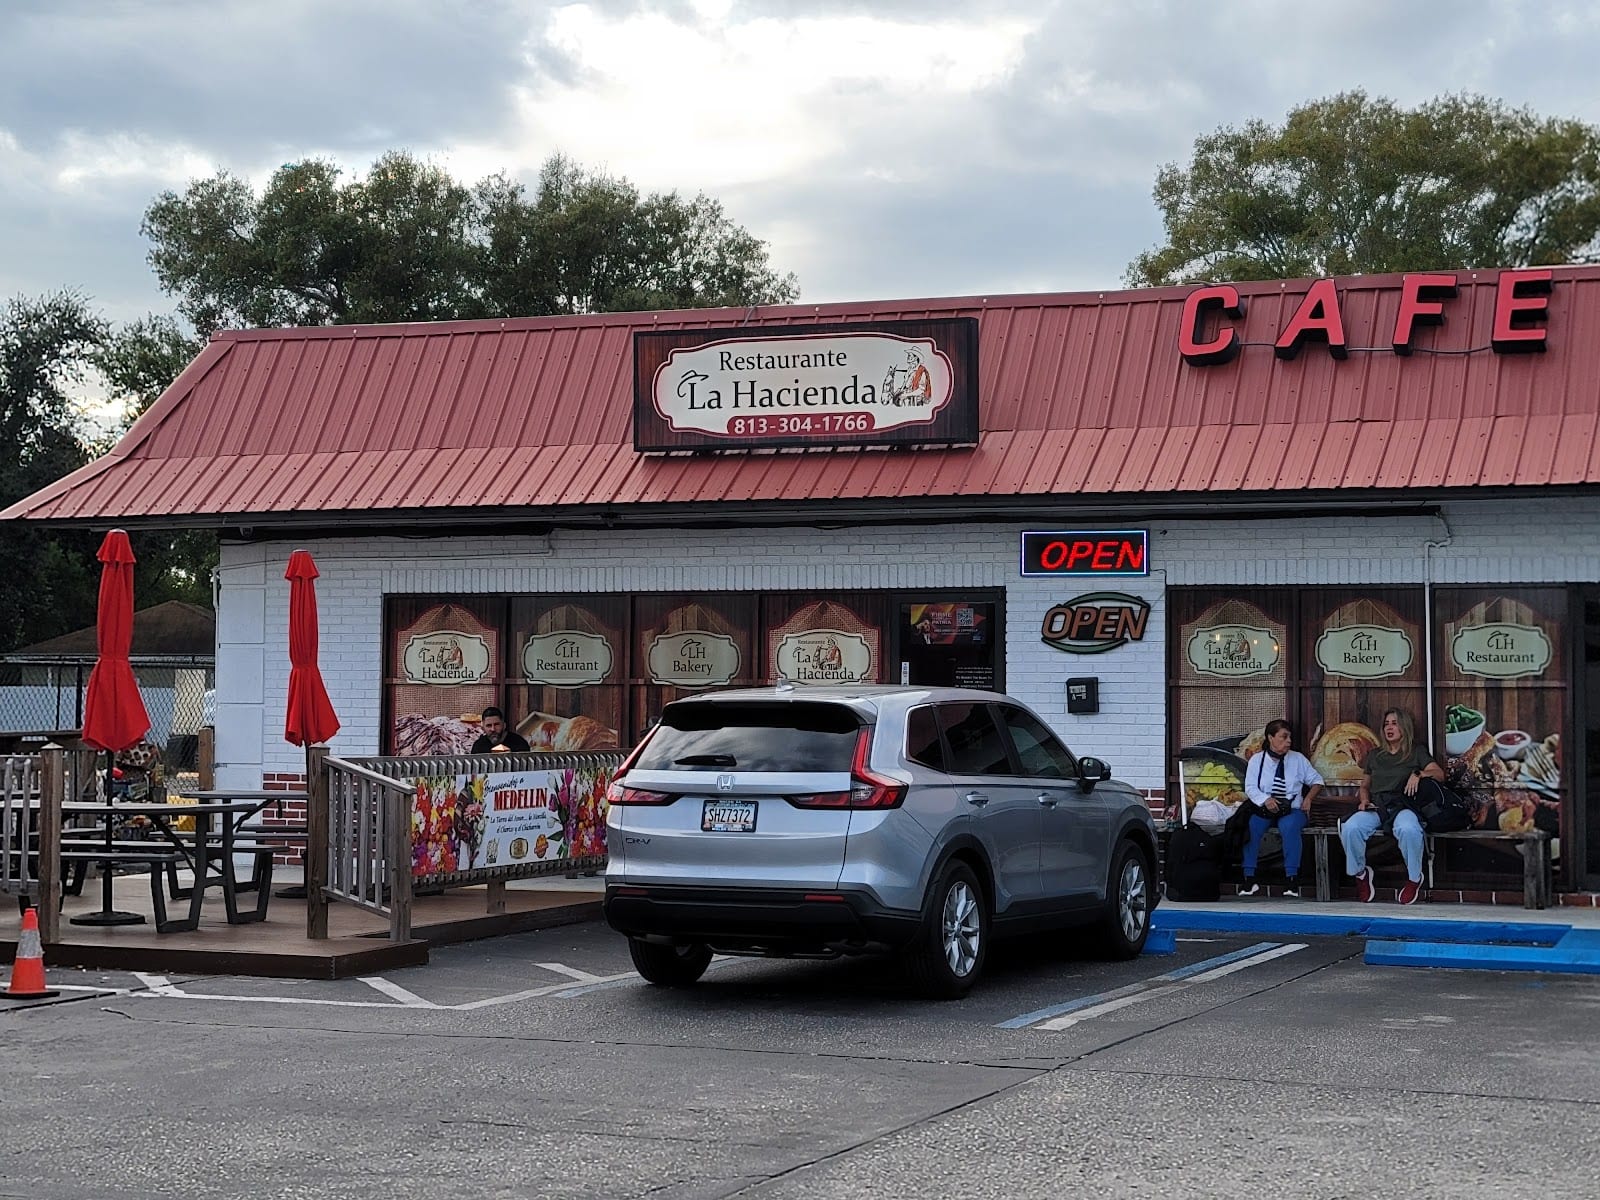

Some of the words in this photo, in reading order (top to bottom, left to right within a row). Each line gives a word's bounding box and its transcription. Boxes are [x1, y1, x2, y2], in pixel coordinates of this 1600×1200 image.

[1178, 269, 1554, 364] CAFE
[719, 349, 847, 371] Restaurante
[687, 381, 723, 410] La
[732, 375, 878, 409] Hacienda
[733, 414, 868, 434] 813-304-1766
[1041, 541, 1143, 569] OPEN
[1042, 605, 1150, 642] OPEN
[1208, 643, 1222, 655] La
[1359, 639, 1377, 651] LH
[1495, 638, 1514, 650] LH
[422, 650, 435, 663] La
[562, 646, 580, 658] LH
[688, 647, 706, 659] LH
[797, 651, 811, 663] La
[1466, 651, 1534, 663] Restaurant
[536, 658, 599, 671] Restaurant
[1208, 657, 1262, 669] Hacienda
[1343, 652, 1385, 667] Bakery
[422, 667, 474, 679] Hacienda
[673, 660, 714, 675] Bakery
[797, 667, 854, 680] Hacienda
[494, 787, 548, 811] MEDELLIN
[708, 808, 751, 823] SHZ7372
